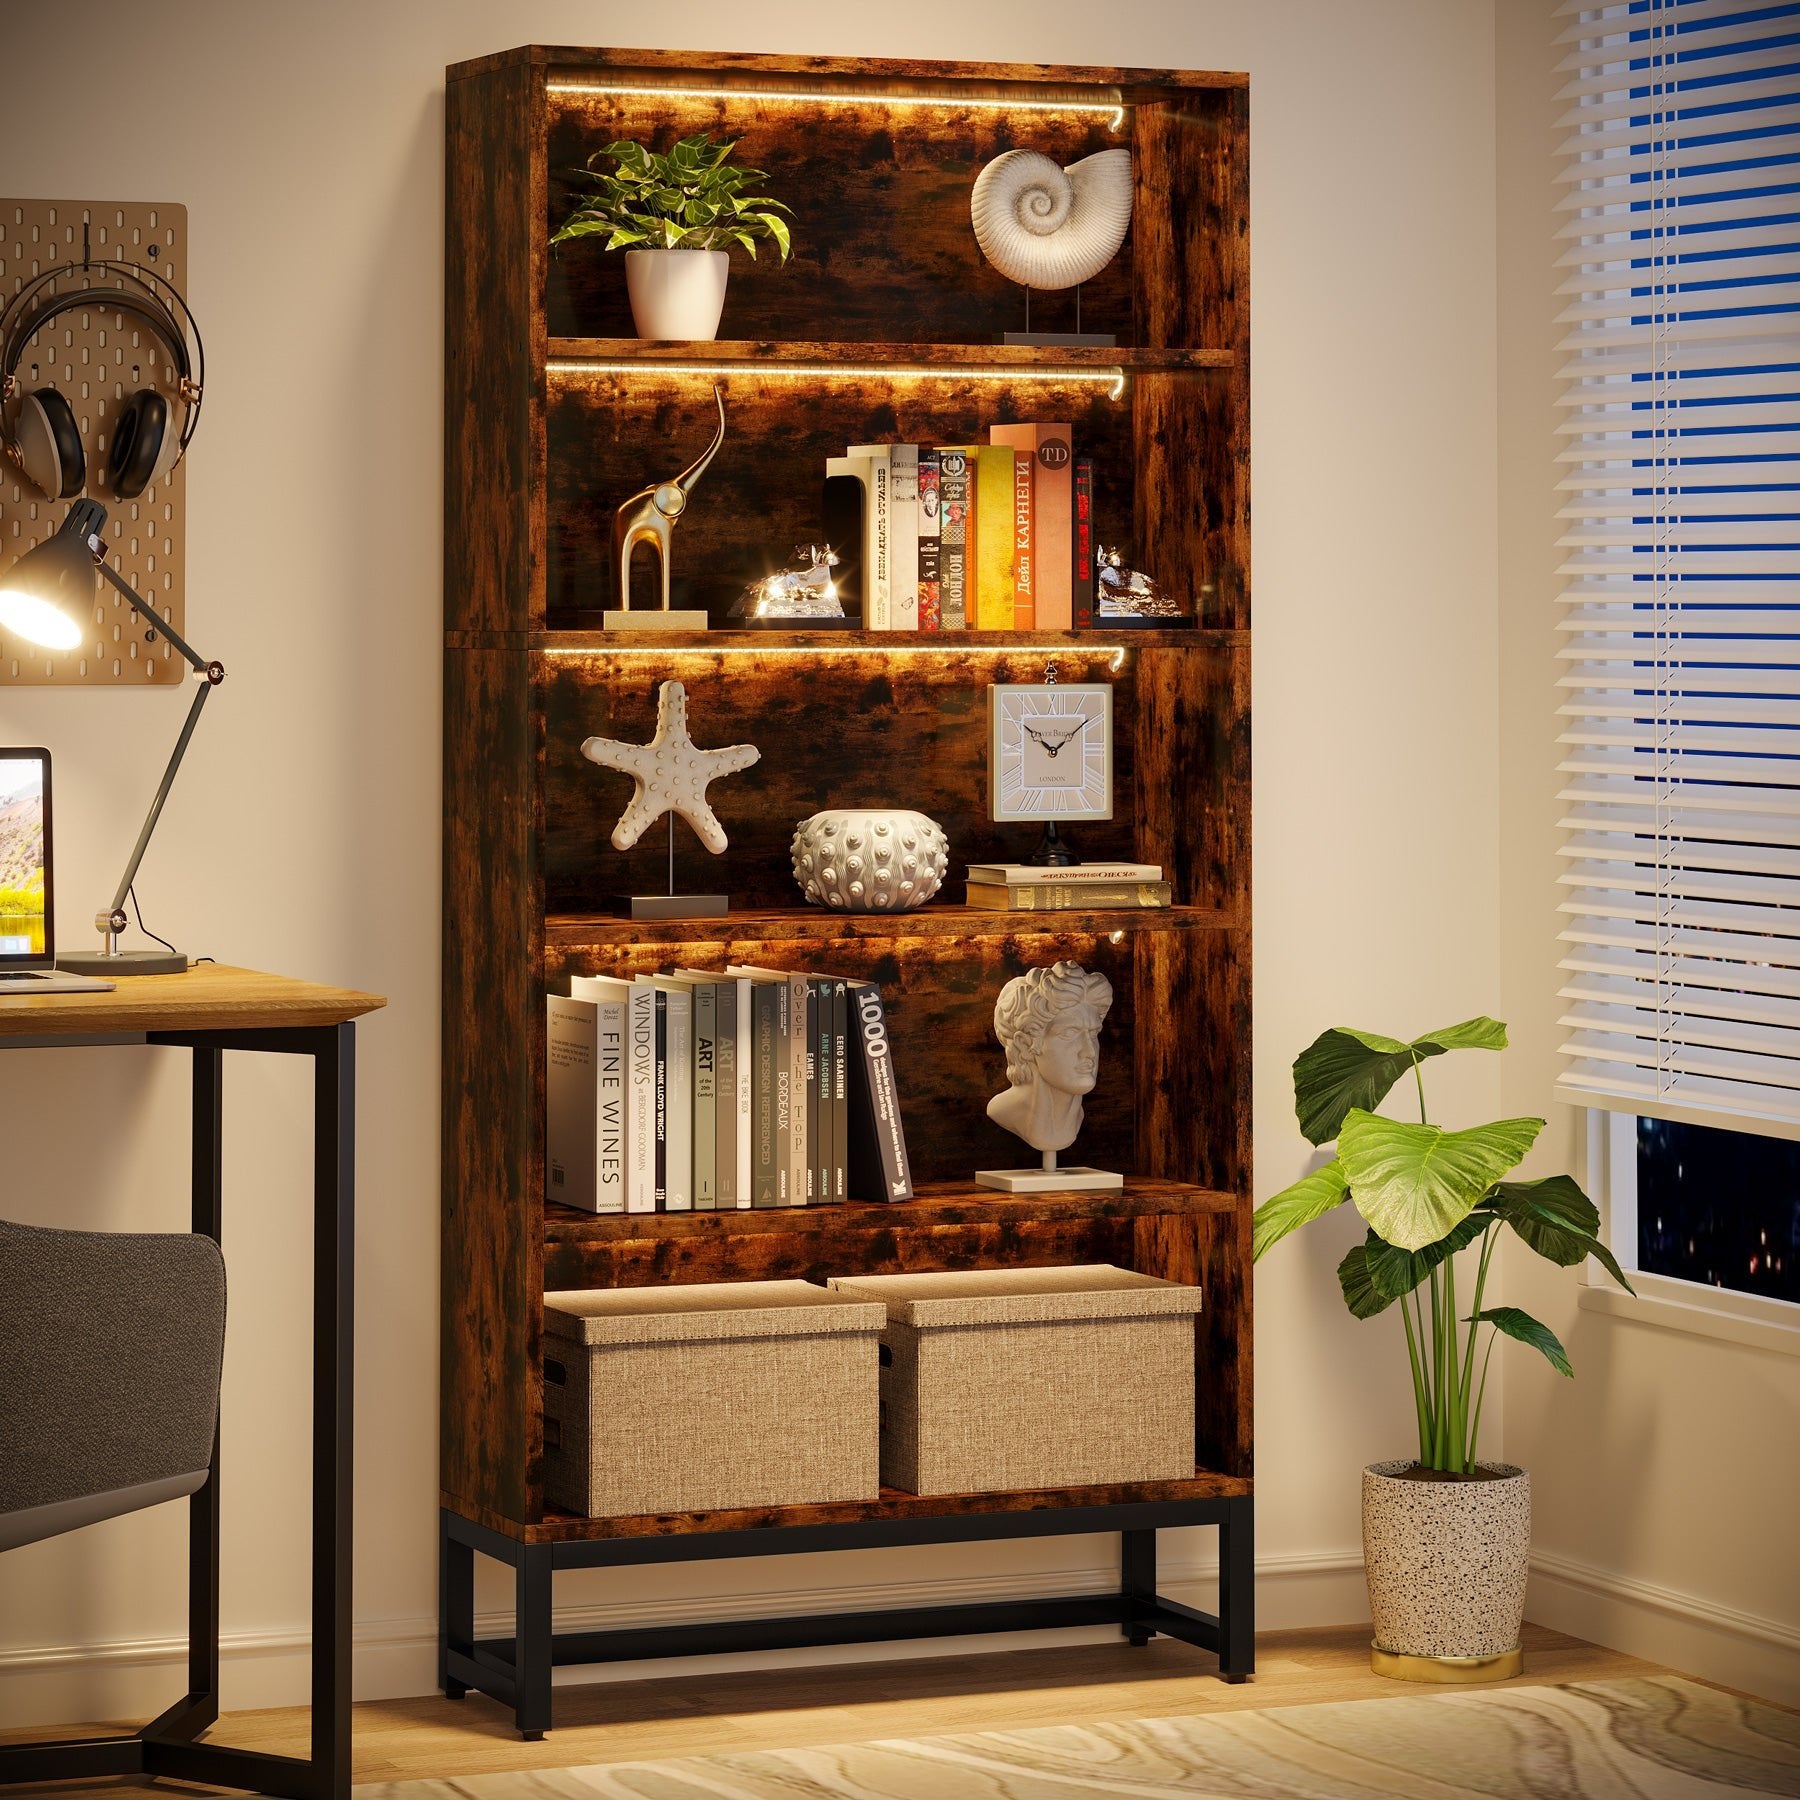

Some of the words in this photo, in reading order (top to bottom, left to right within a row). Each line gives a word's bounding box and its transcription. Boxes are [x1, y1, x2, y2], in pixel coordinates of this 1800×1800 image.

[1042, 447, 1067, 461] TD
[878, 468, 886, 515] СТУЛЬЕВ
[1017, 461, 1029, 550] КАРНЕГИ
[950, 554, 964, 607] ЛОНДОН
[1017, 556, 1031, 595] Дейл
[761, 1006, 770, 1052] GRAPHIC
[794, 984, 804, 1036] Over
[859, 992, 887, 1057] 1000
[603, 1033, 619, 1087] FINE
[634, 993, 650, 1085] WINDOWS
[699, 1037, 713, 1072] ART
[720, 1036, 734, 1071] ART
[657, 1061, 665, 1085] FRANK
[761, 1055, 770, 1093] DESIGN
[884, 1086, 892, 1095] the
[638, 1095, 647, 1131] BERGDORF
[657, 1086, 665, 1110] LLOYD
[778, 1072, 789, 1130] BORDEAUX
[603, 1100, 619, 1184] WINES
[657, 1111, 665, 1141] WRIGHT
[761, 1097, 770, 1165] REFERENCED
[794, 1106, 803, 1150] Top
[638, 1133, 647, 1171] GOODMAN
